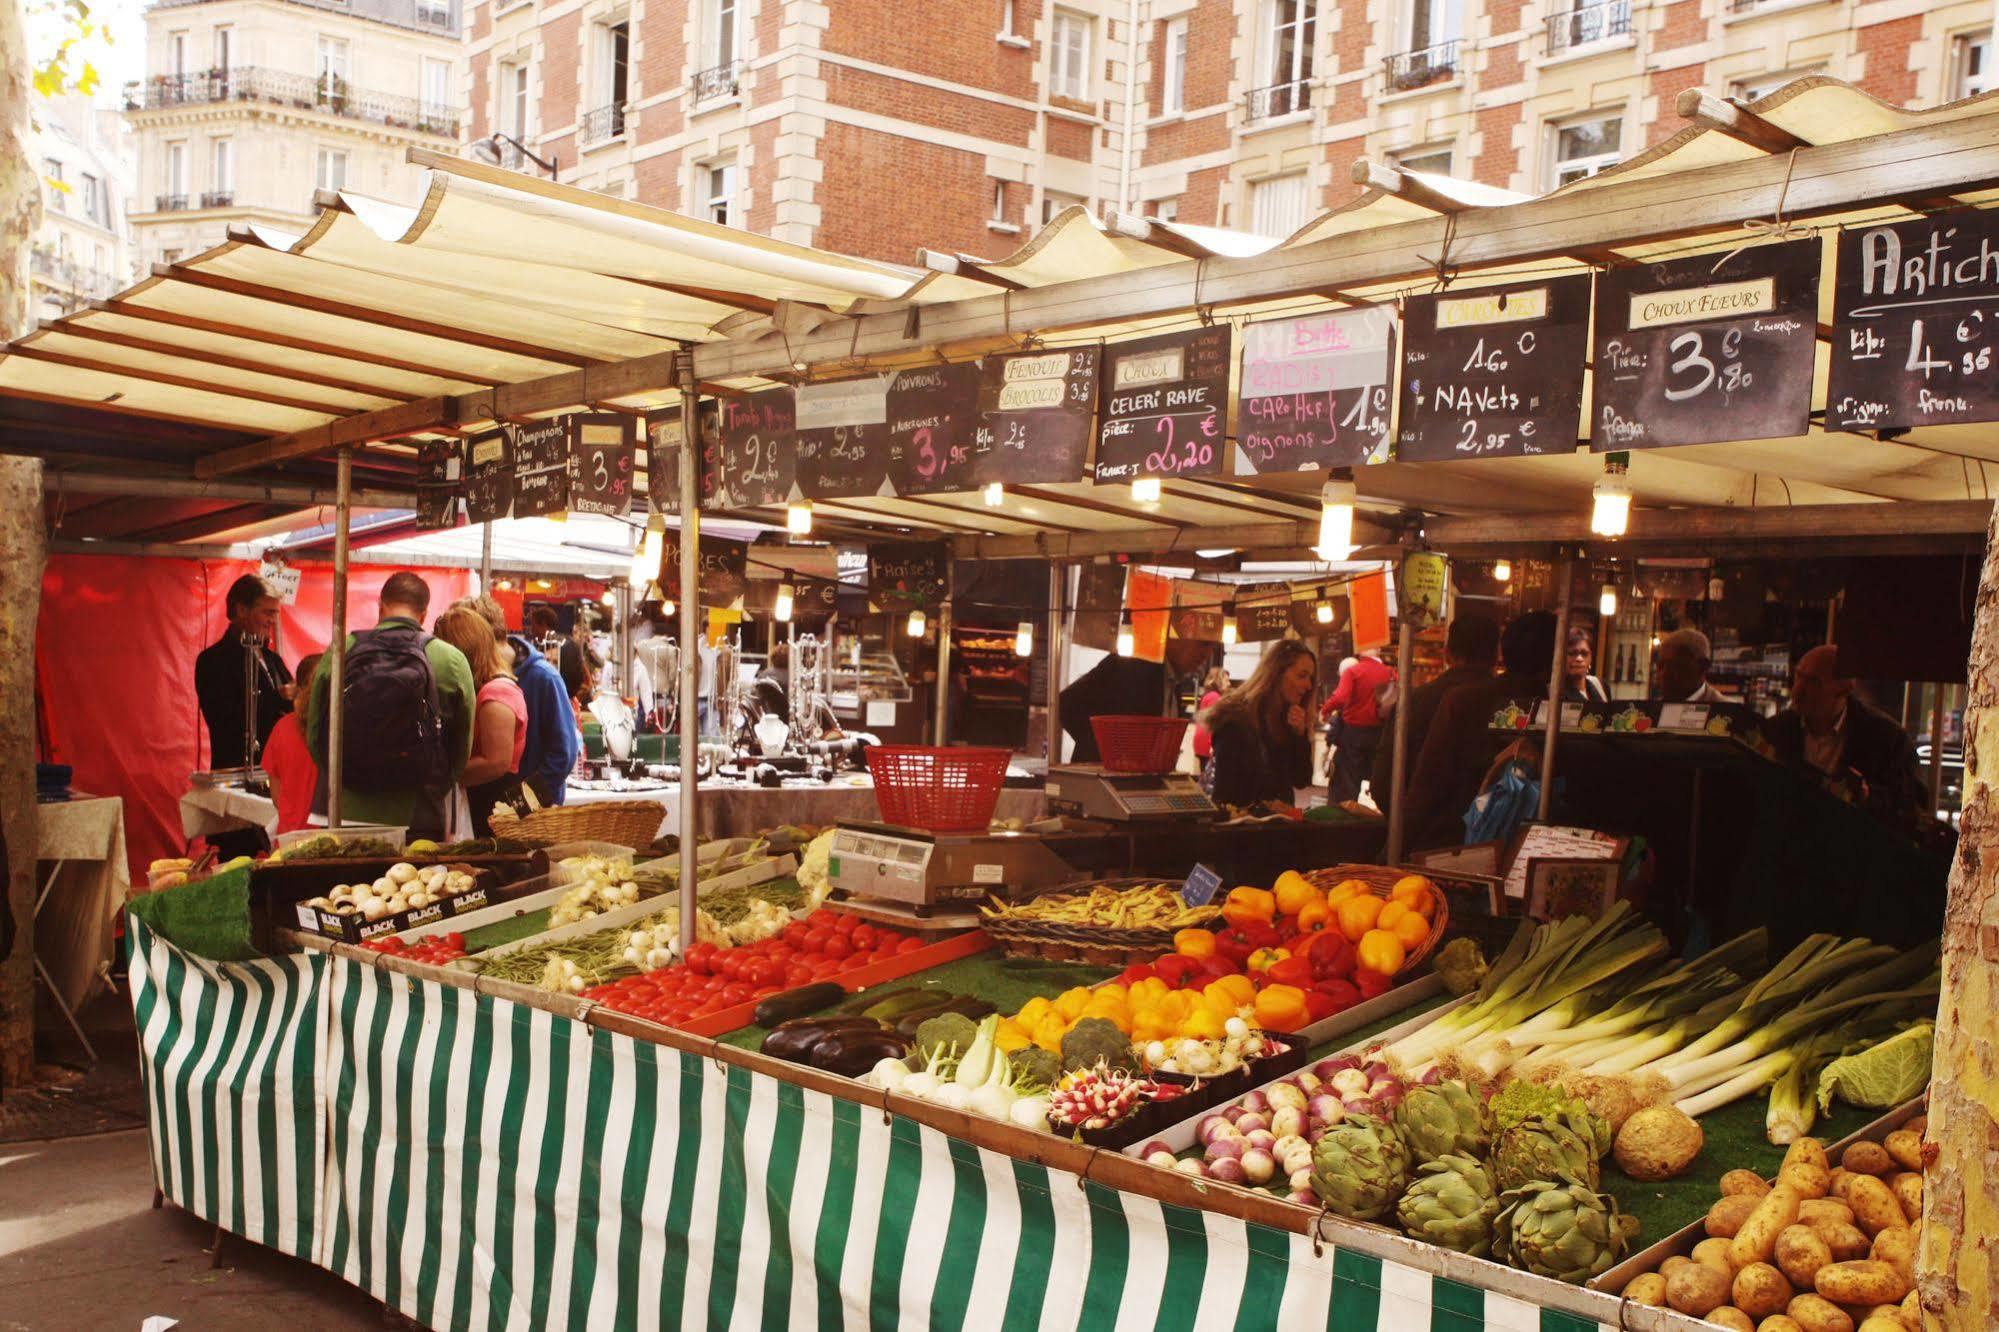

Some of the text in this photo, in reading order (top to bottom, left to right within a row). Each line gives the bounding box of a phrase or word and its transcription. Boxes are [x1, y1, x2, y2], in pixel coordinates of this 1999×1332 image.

[1643, 291, 1761, 321] CHOUX FLEURS
[1166, 387, 1209, 408] RAVE
[453, 889, 487, 909] BLACK
[408, 904, 442, 923] BLACK
[360, 919, 396, 938] BLACK
